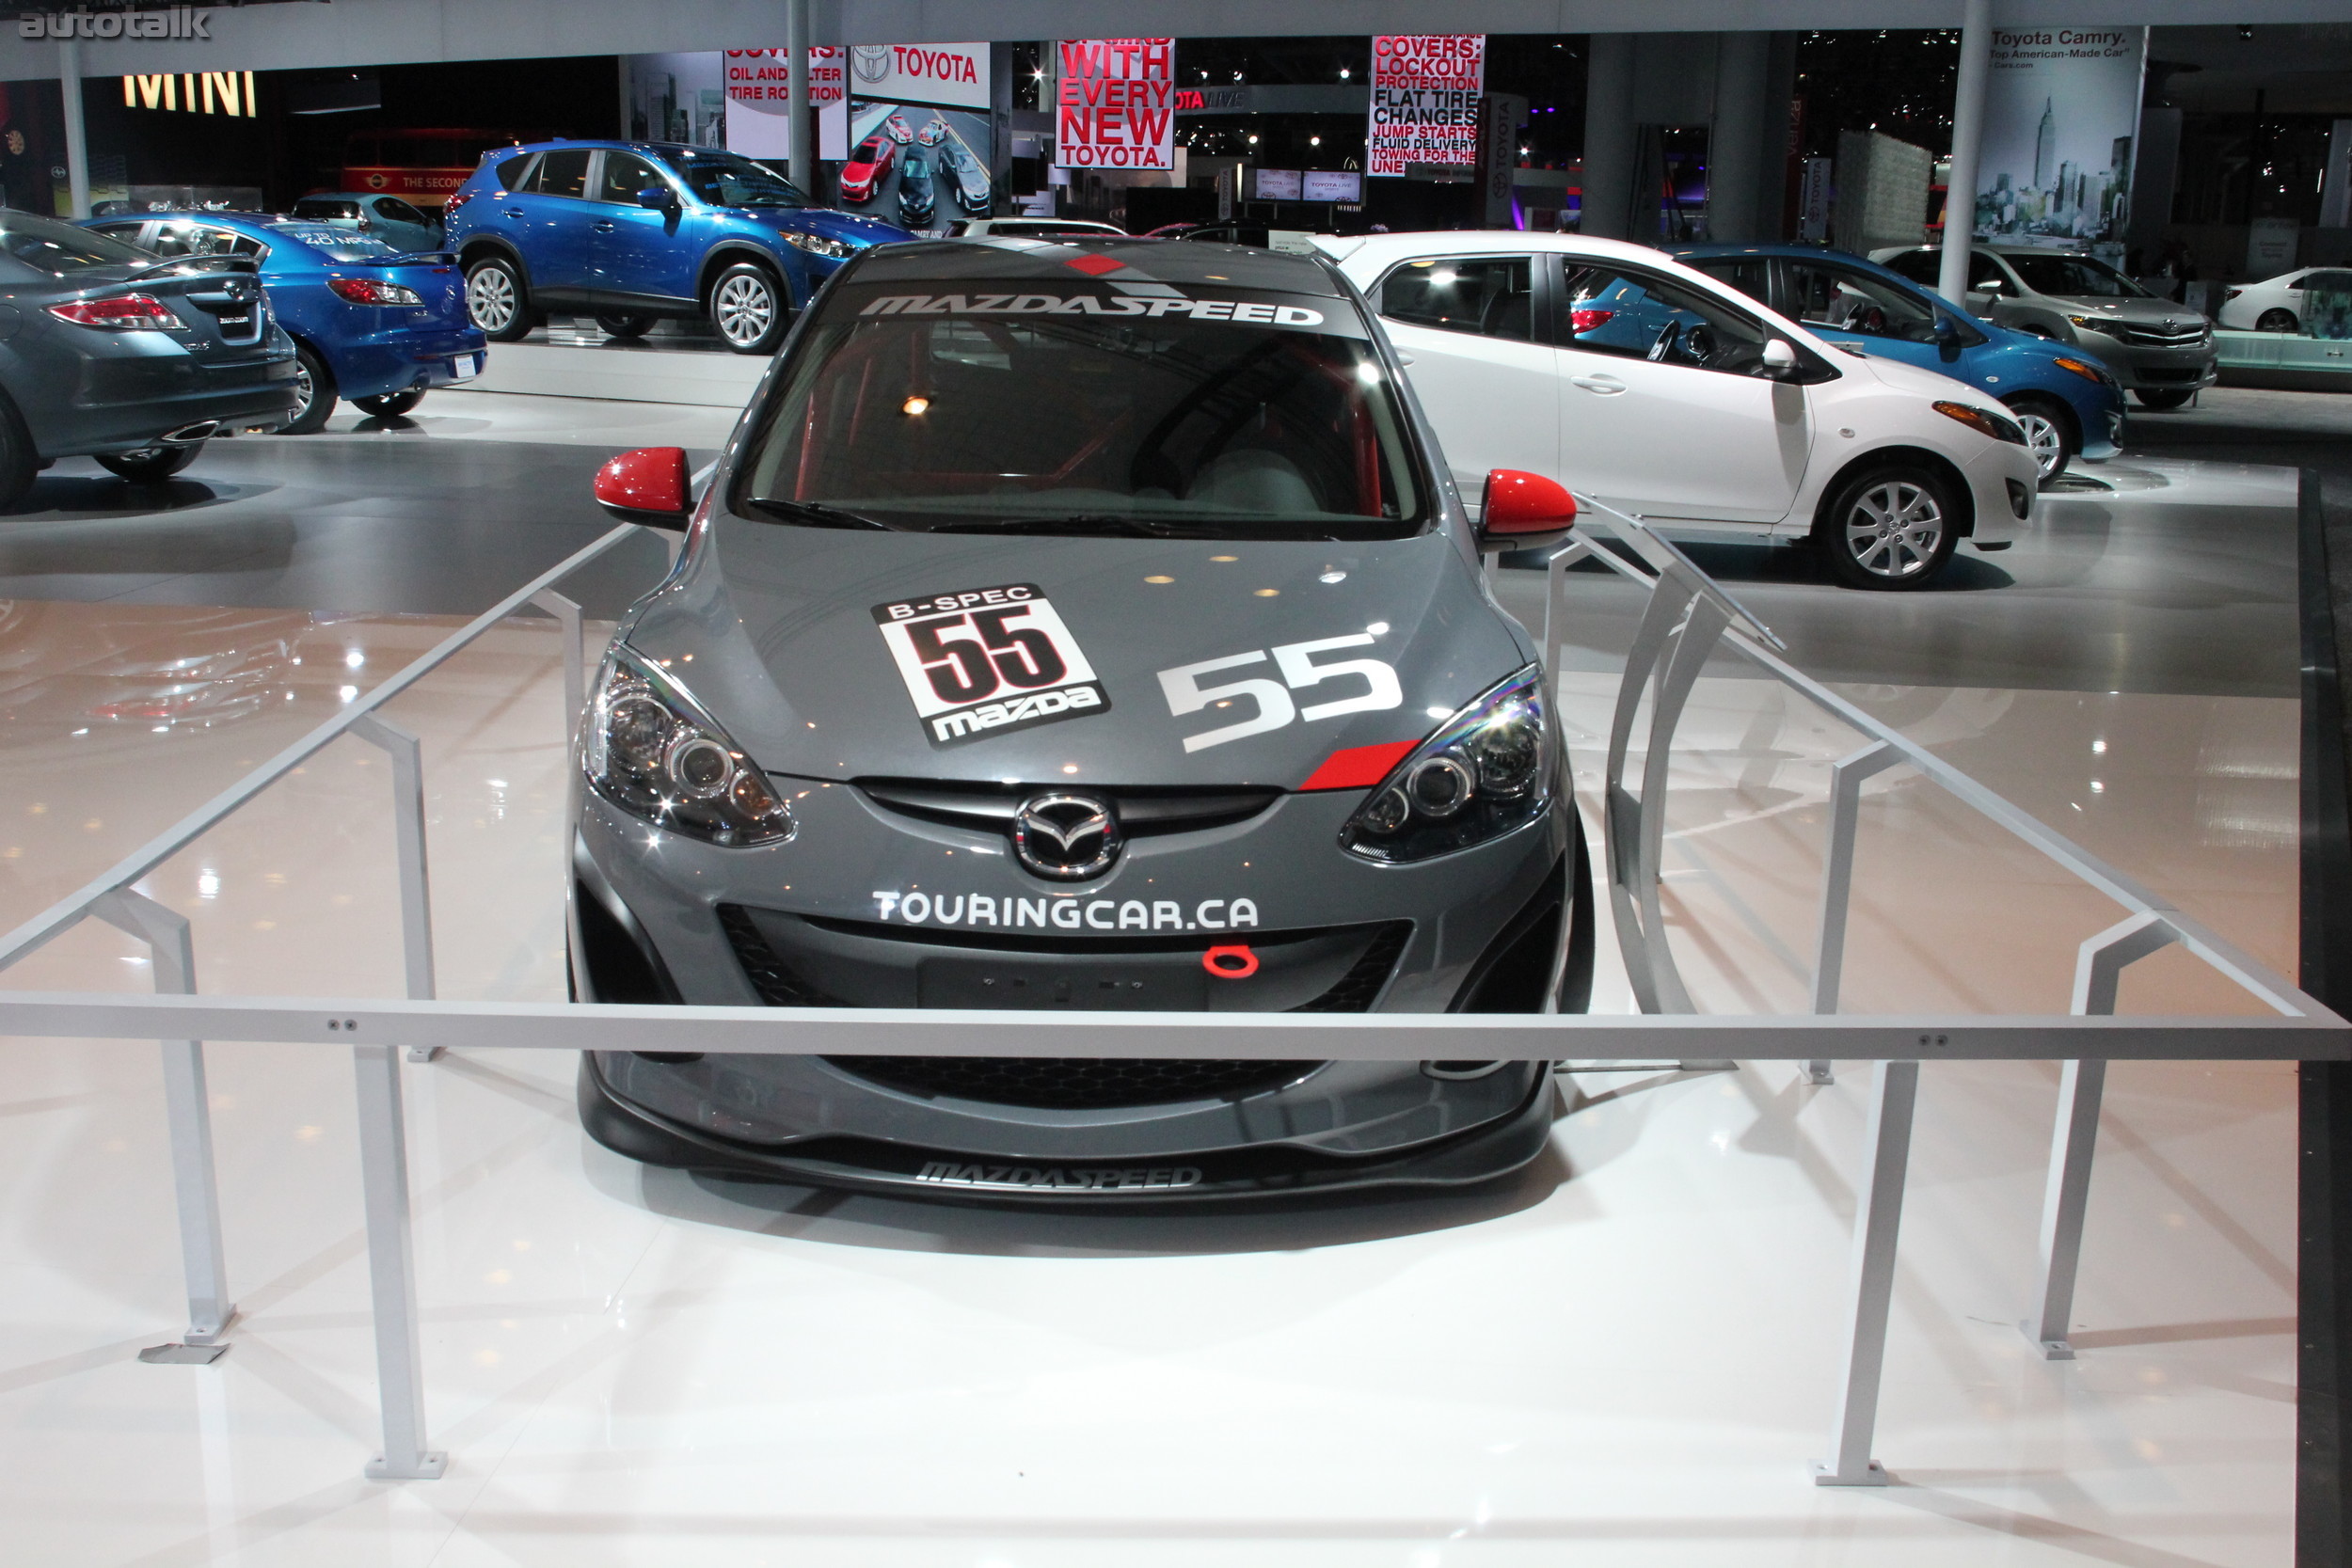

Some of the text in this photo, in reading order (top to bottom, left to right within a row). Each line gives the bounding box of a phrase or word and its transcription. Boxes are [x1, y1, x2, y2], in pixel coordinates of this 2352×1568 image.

[1375, 36, 1481, 58] COVERS:
[1992, 30, 2126, 48] Toyota Camry.
[1060, 44, 1168, 79] WITH
[2011, 49, 2101, 59] American-Made
[729, 67, 754, 81] OIL
[756, 68, 788, 81] AND
[894, 46, 977, 84] TOYOTA
[1375, 57, 1481, 76] LOCKOUT
[1059, 78, 1173, 107] EVERY
[1375, 75, 1479, 90] PROTECTION
[123, 71, 256, 118] MINI
[729, 87, 842, 100] TIRE ROTION
[1175, 91, 1205, 110] OTA
[1375, 88, 1479, 108] FLAT TIRE
[1060, 106, 1170, 146] NEW
[1374, 107, 1478, 126] CHANGES
[1373, 125, 1477, 140] JUMP STARTS
[1496, 102, 1510, 167] TOYOTA
[1373, 138, 1476, 150] FLUID DELIVERY
[1060, 146, 1166, 166] TOYOTA.
[1372, 150, 1476, 161] TOWING FOR THE
[403, 177, 423, 188] THE
[1810, 161, 1822, 204] TOYOTA
[306, 236, 335, 245] 40
[336, 236, 373, 245] MPG
[859, 293, 1325, 326] MAZDASPEED
[887, 586, 1033, 620] B-SPEC
[903, 604, 1069, 705] 55
[1156, 632, 1404, 753] 55
[872, 890, 1259, 929] TOURINGCAR.CA
[915, 1161, 1202, 1189] MAZDASPEED
